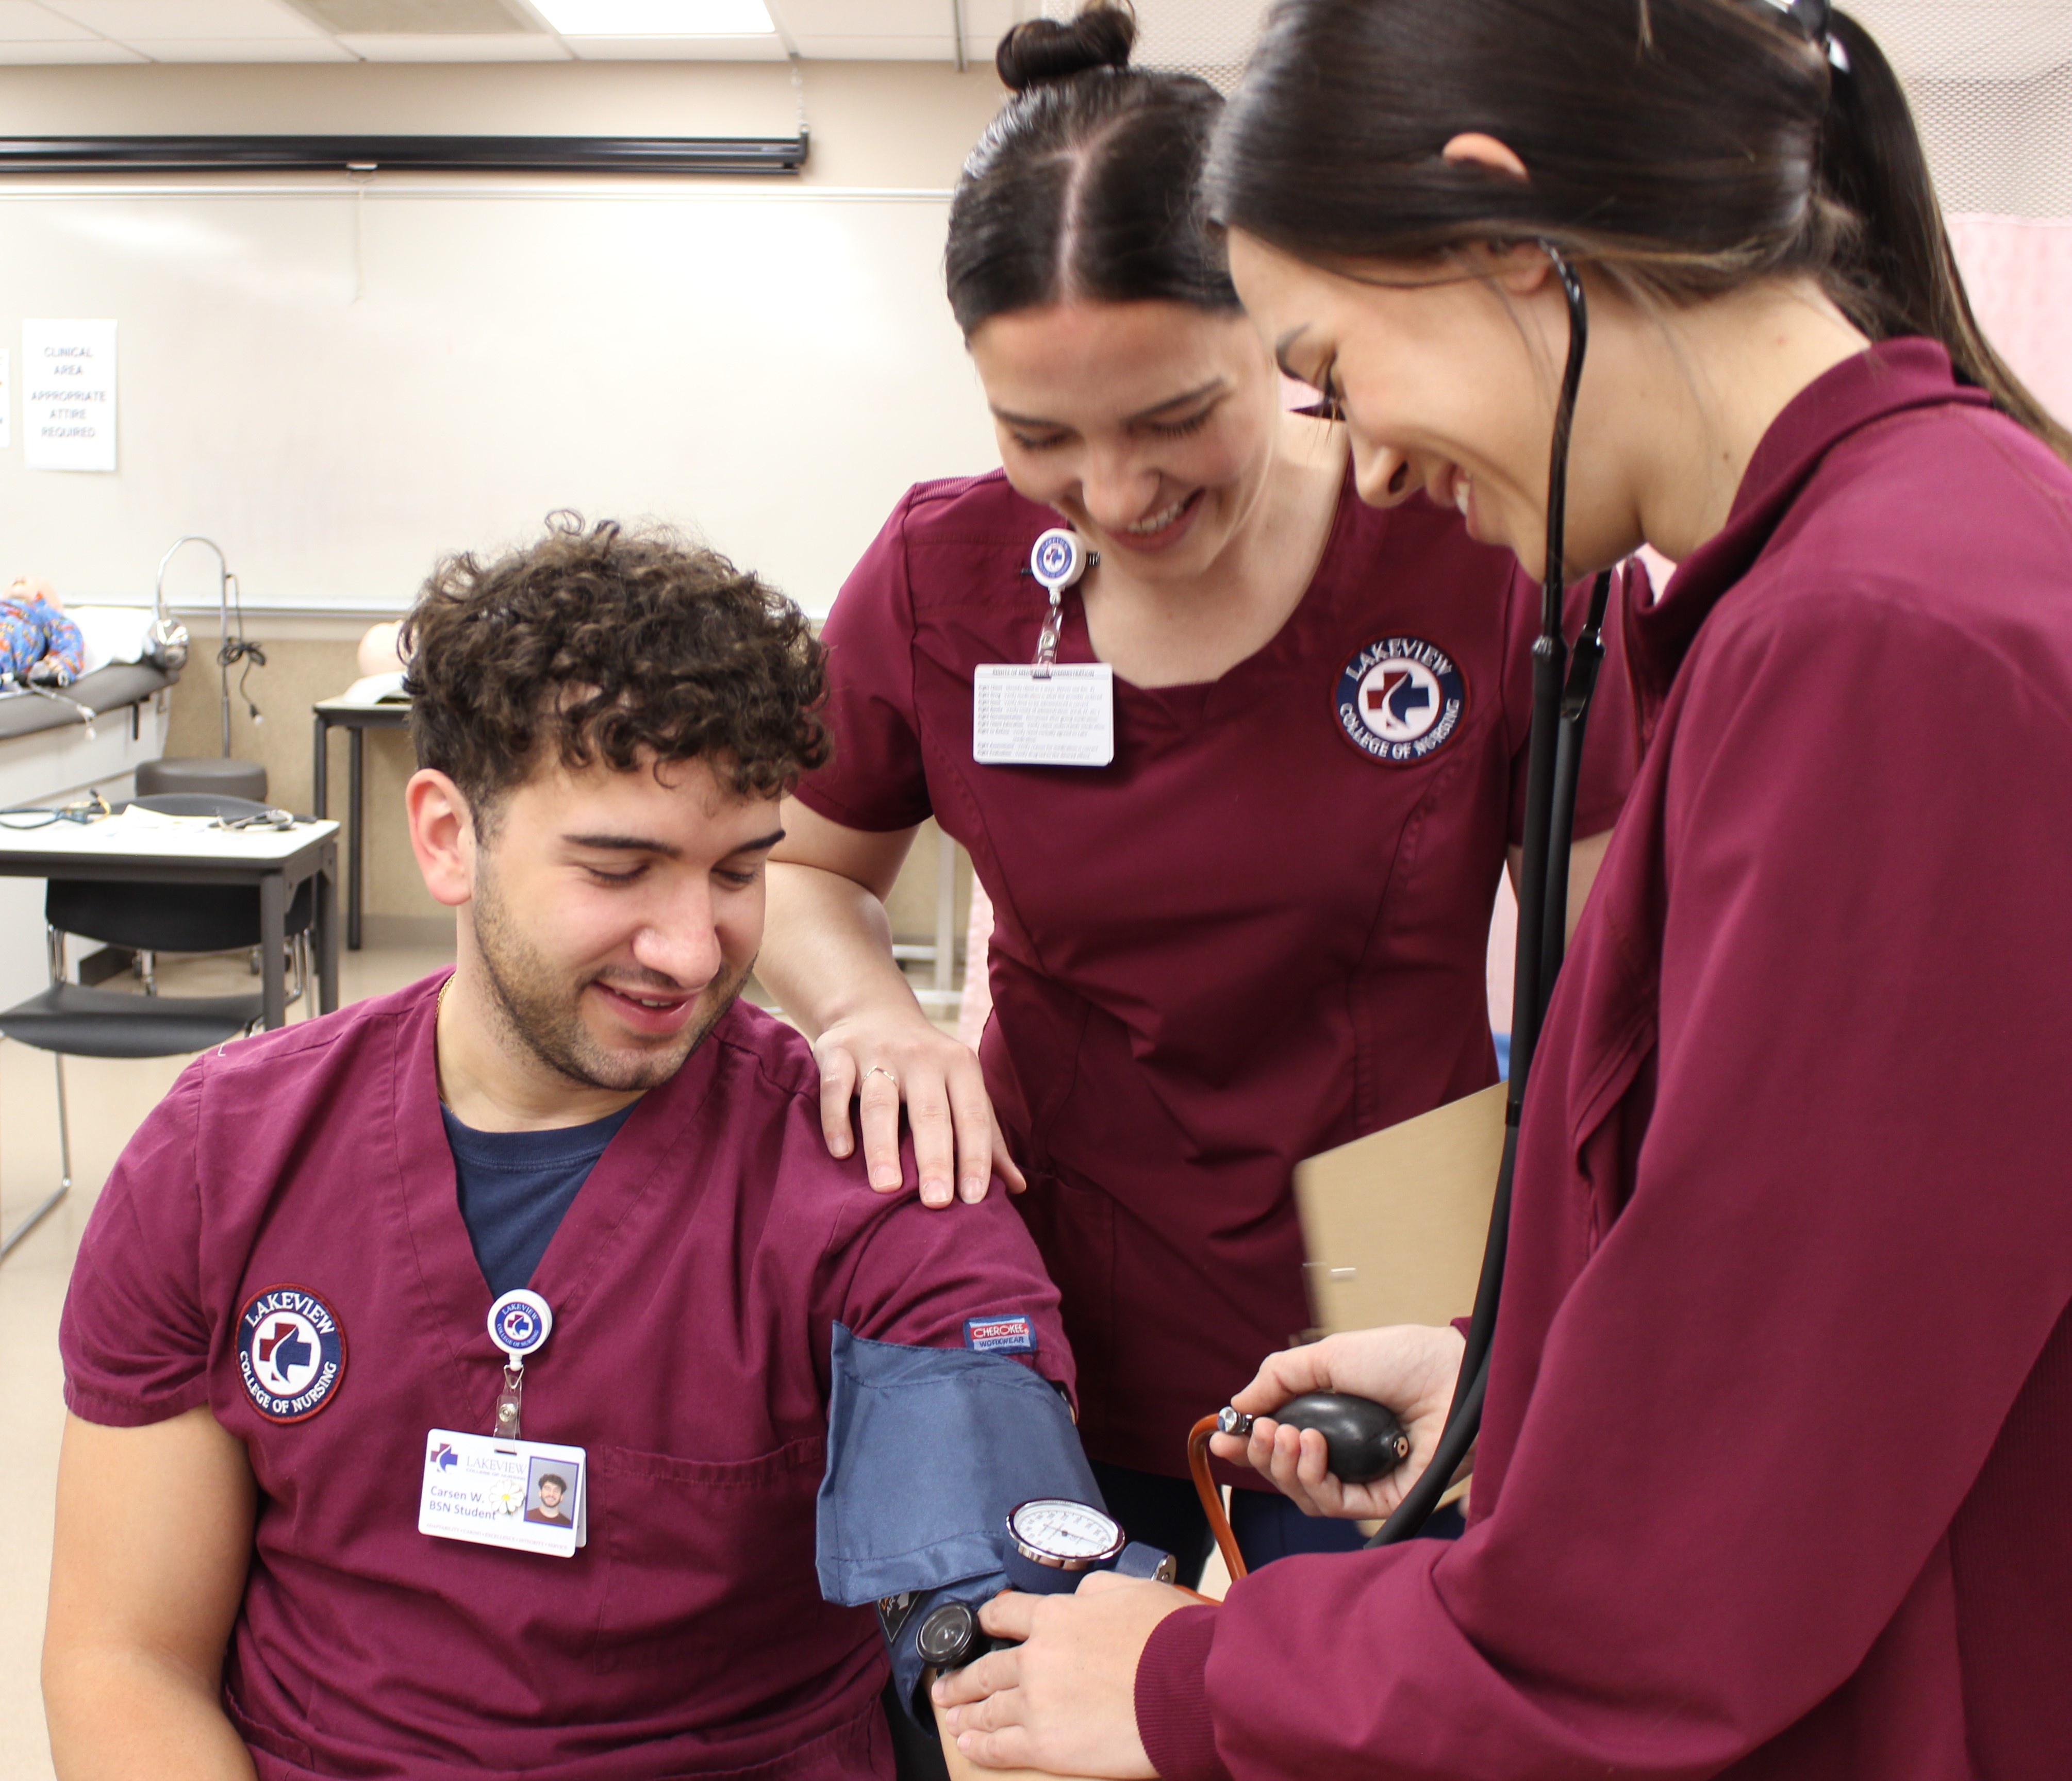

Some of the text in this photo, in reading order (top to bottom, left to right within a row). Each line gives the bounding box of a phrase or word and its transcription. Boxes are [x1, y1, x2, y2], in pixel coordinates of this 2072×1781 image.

[44, 346, 93, 357] CLINICAL
[54, 364, 83, 375] AREA
[31, 390, 107, 402] APPROPRIATE
[49, 408, 87, 419] ATTIRE
[41, 426, 96, 438] REQUIRED
[1345, 638, 1452, 682] LAKEVIEW
[1340, 698, 1460, 760] COLLEGE OF NURSING
[245, 1292, 336, 1334] LAKEVIEW
[502, 1303, 538, 1320] LAKEVIEW
[974, 1324, 1024, 1338] CHEROKEE
[980, 1337, 1024, 1347] WORKWEAR
[240, 1351, 337, 1413] COLLEGE OF NURSING
[467, 1455, 527, 1474] LAKEVIEW
[430, 1485, 485, 1504] Carsen W.
[429, 1501, 497, 1520] BSN Student
